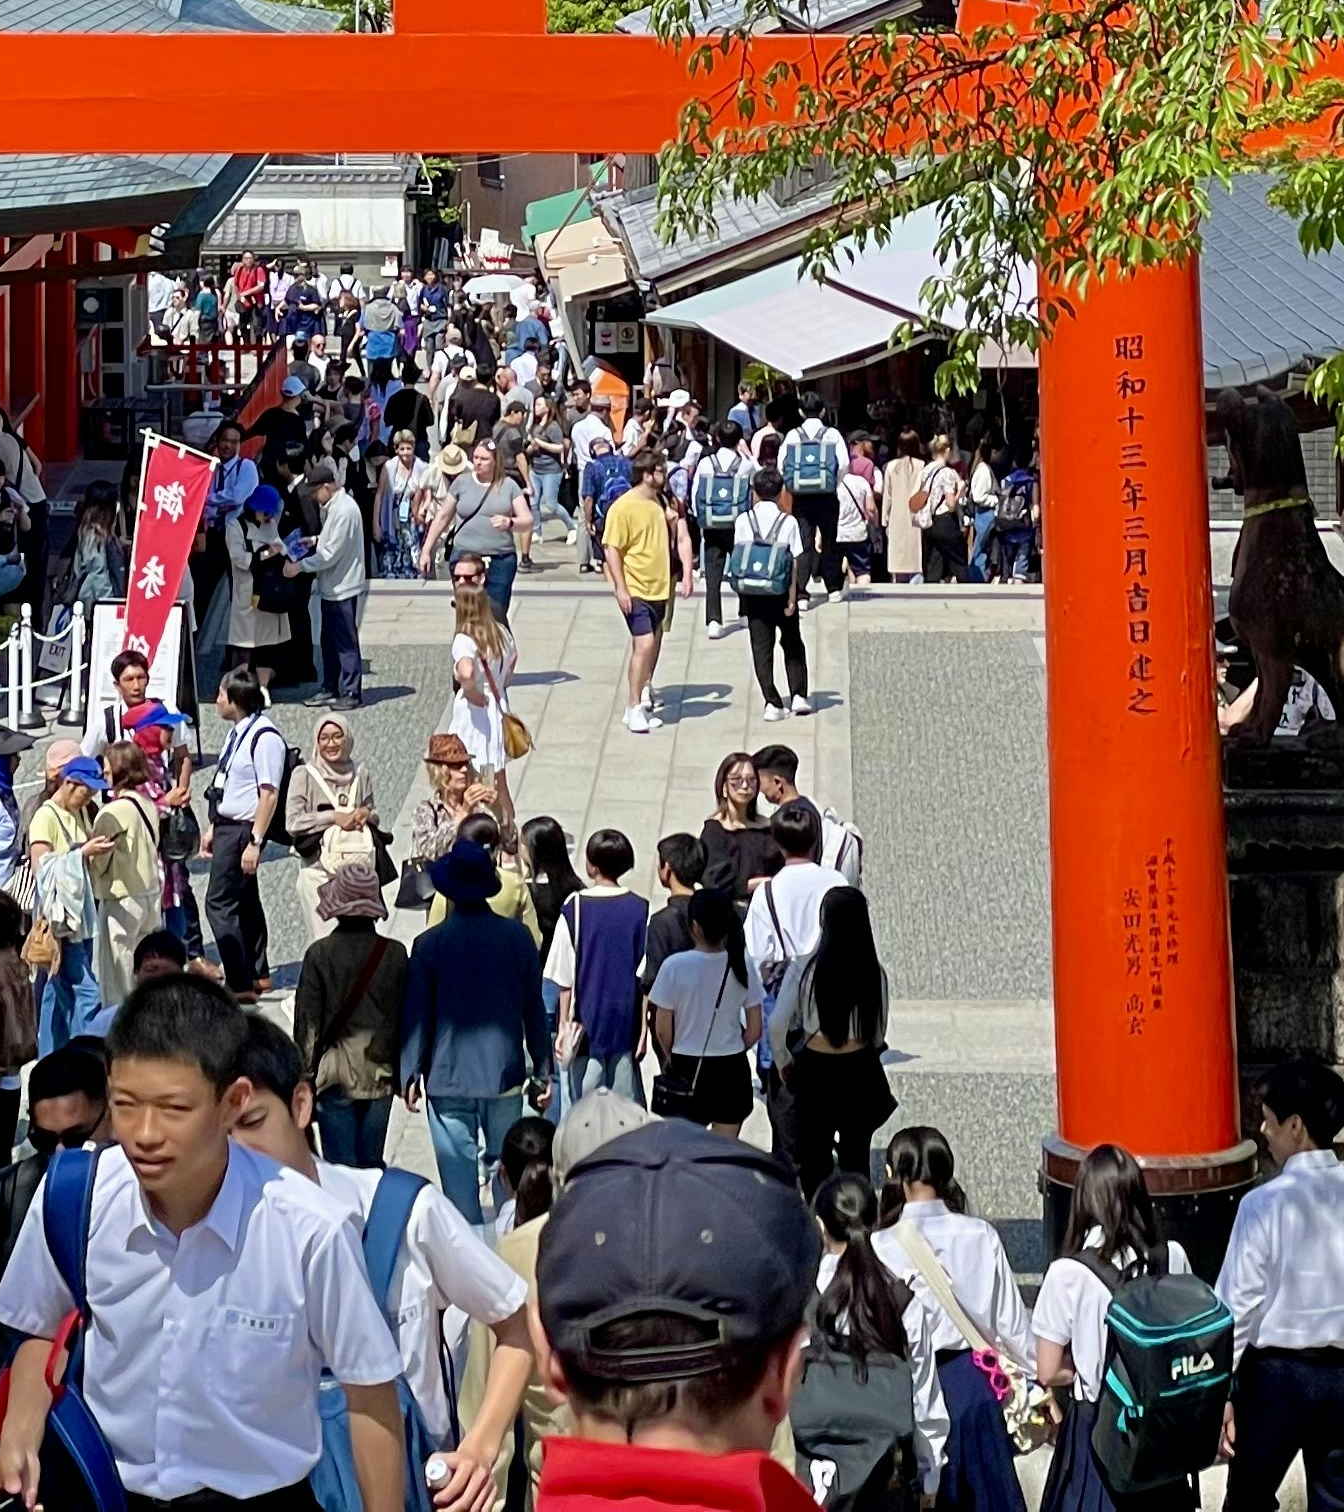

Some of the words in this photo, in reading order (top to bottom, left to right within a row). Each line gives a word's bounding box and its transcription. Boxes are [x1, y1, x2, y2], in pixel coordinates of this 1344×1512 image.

[1114, 334, 1157, 716] 昭和十三年三月吉日建之
[49, 643, 66, 657] EXIT
[1171, 1352, 1215, 1380] FILA
